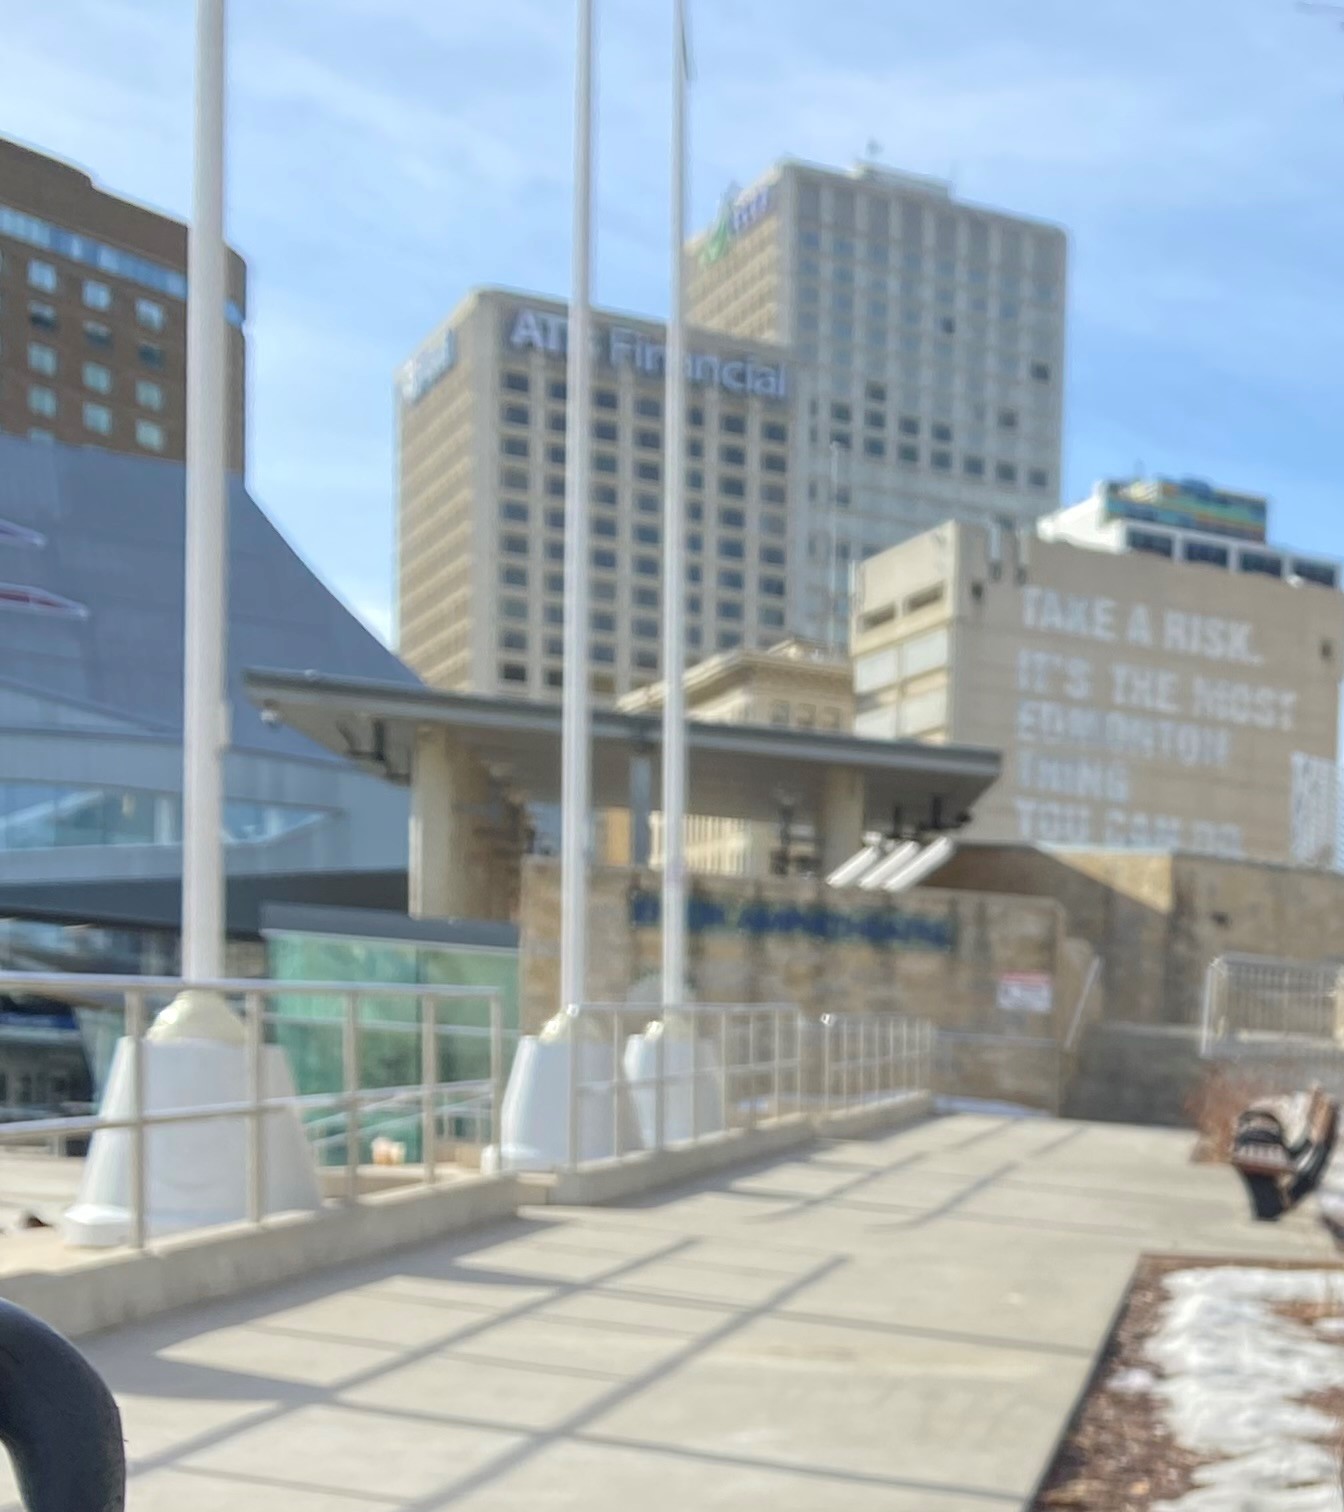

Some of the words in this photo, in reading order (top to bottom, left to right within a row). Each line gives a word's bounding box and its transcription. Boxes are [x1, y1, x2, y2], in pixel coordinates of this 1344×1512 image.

[1020, 584, 1115, 643] TAKE
[1126, 603, 1153, 647] A
[1111, 662, 1182, 714] THE
